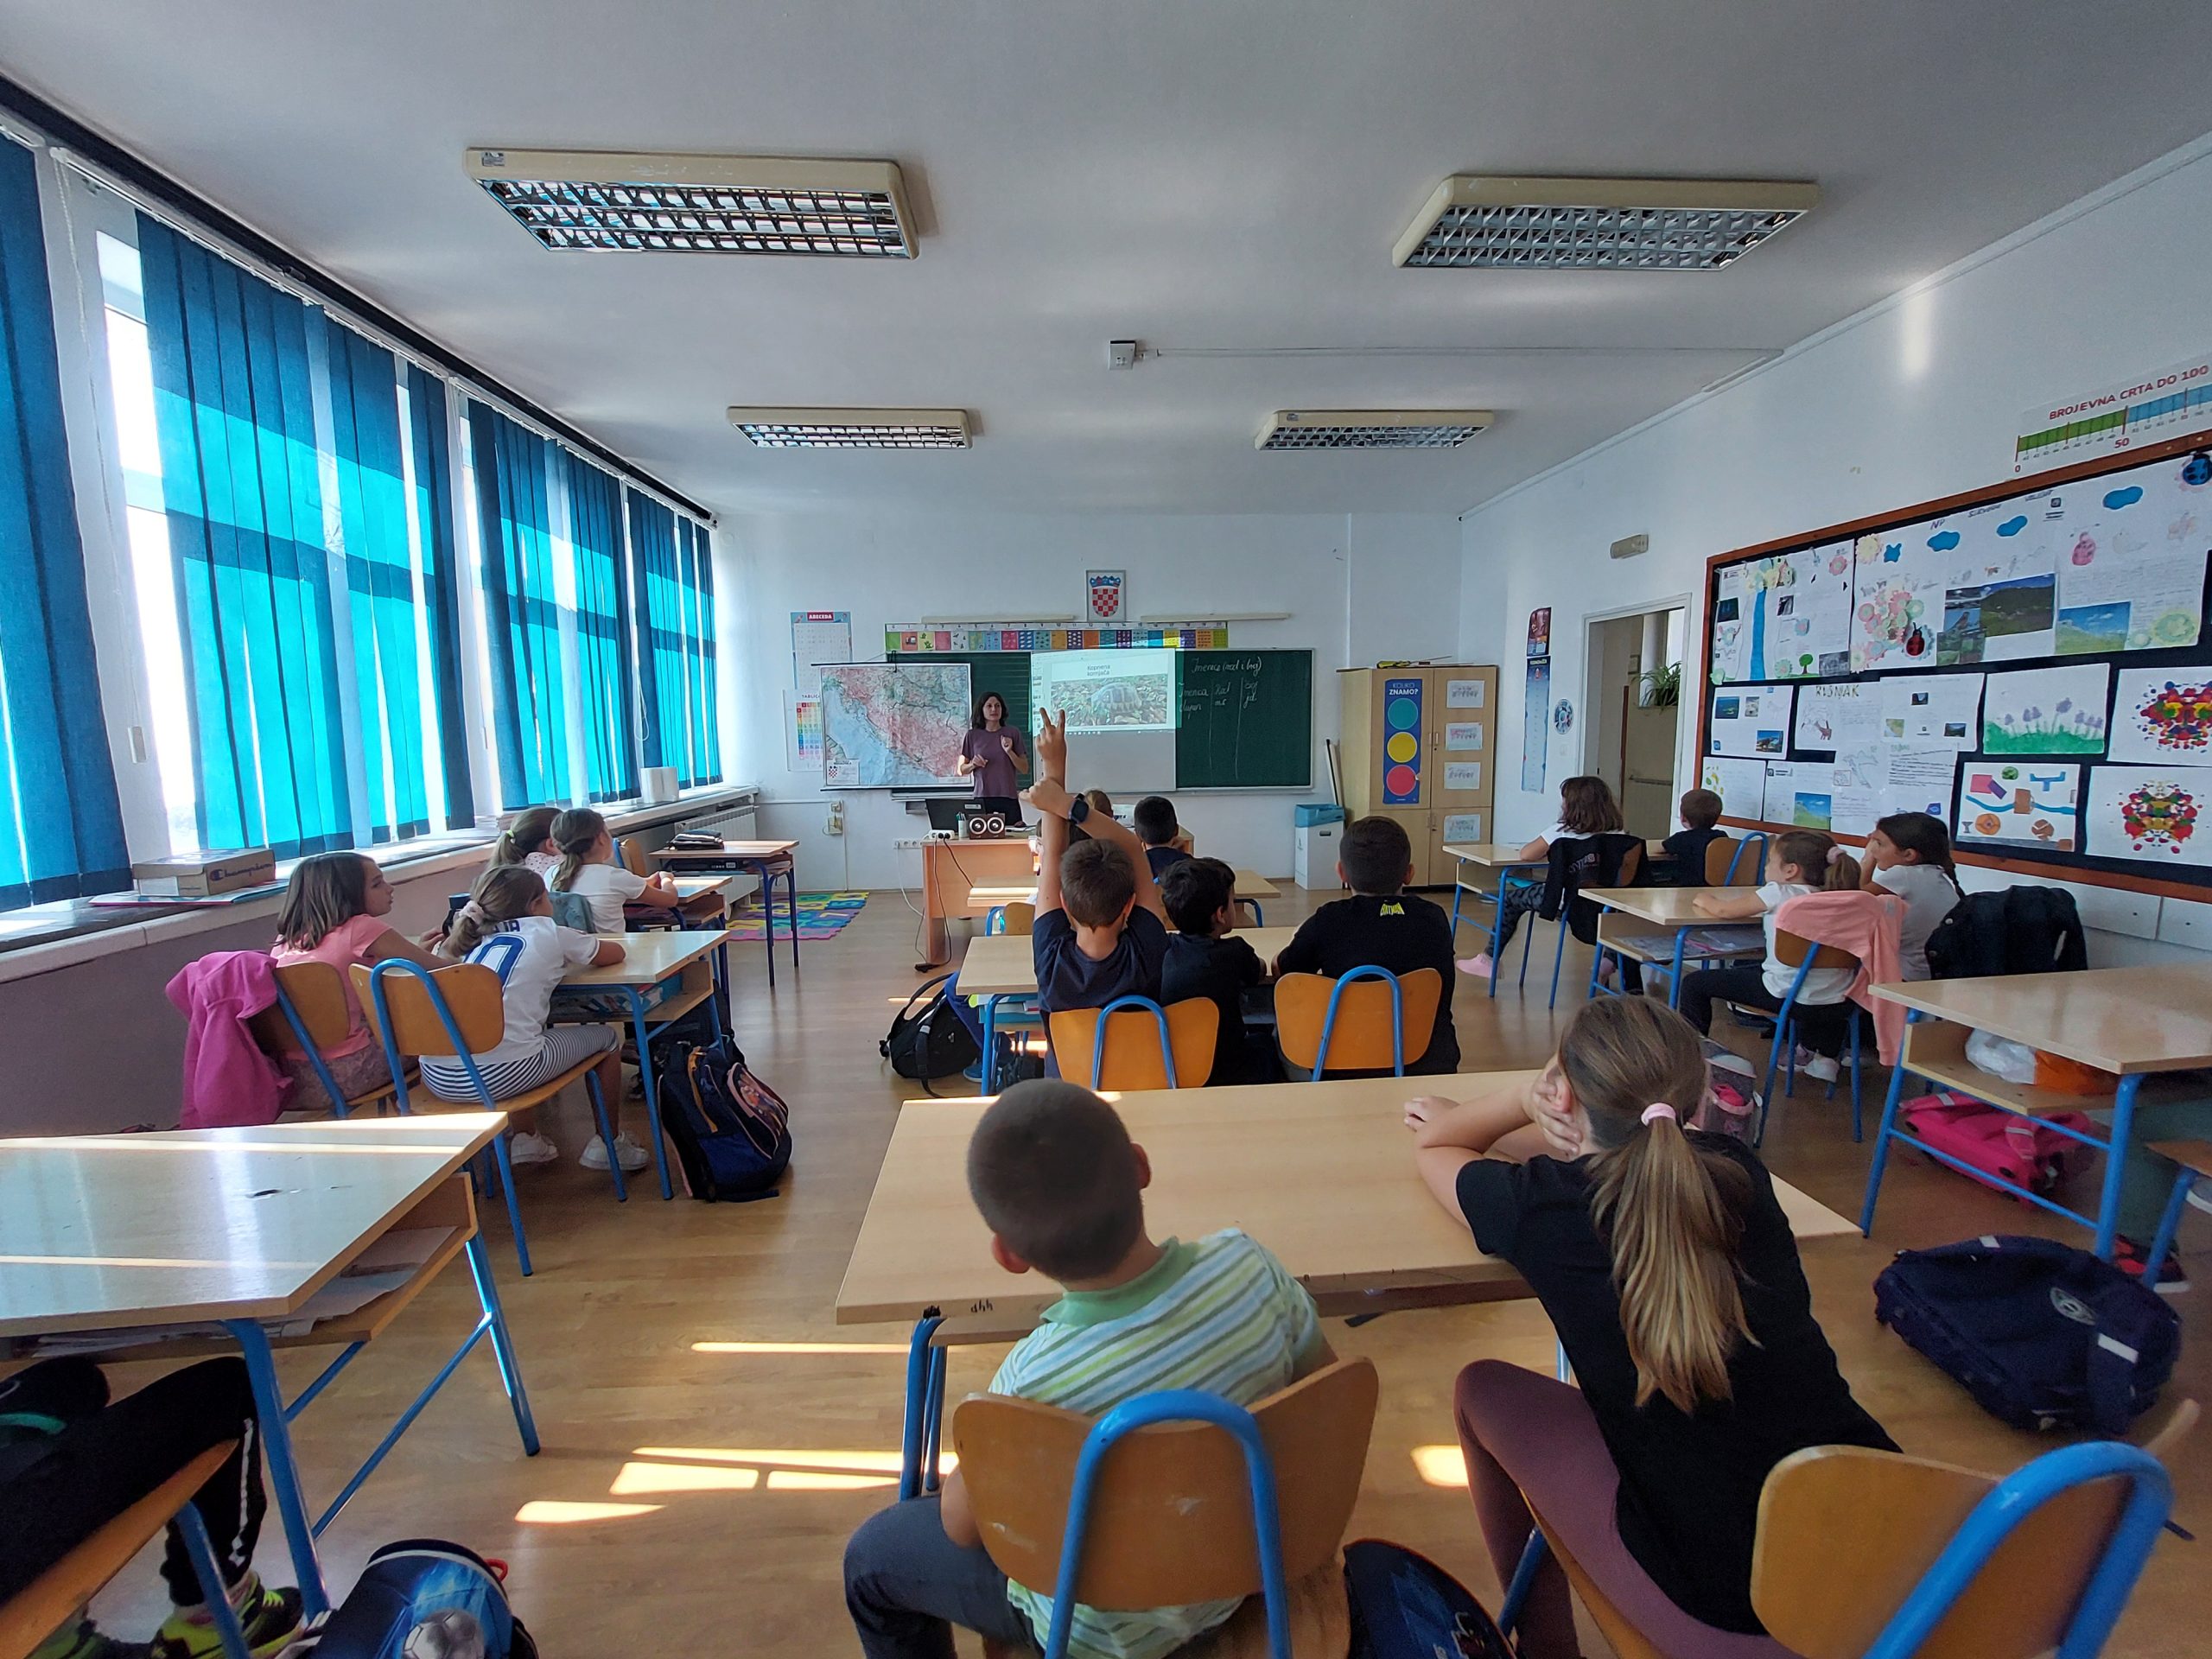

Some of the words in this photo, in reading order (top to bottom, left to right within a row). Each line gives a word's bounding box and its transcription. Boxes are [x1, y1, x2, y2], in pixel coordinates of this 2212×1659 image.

[2049, 394, 2116, 420] BROJEVNA
[2120, 383, 2154, 400] CRTA
[2157, 375, 2177, 389] DO
[2181, 365, 2209, 381] 100
[2014, 464, 2021, 473] 0
[2114, 437, 2130, 449] 50
[210, 863, 274, 882] Champion
[970, 1298, 994, 1313] dhh
